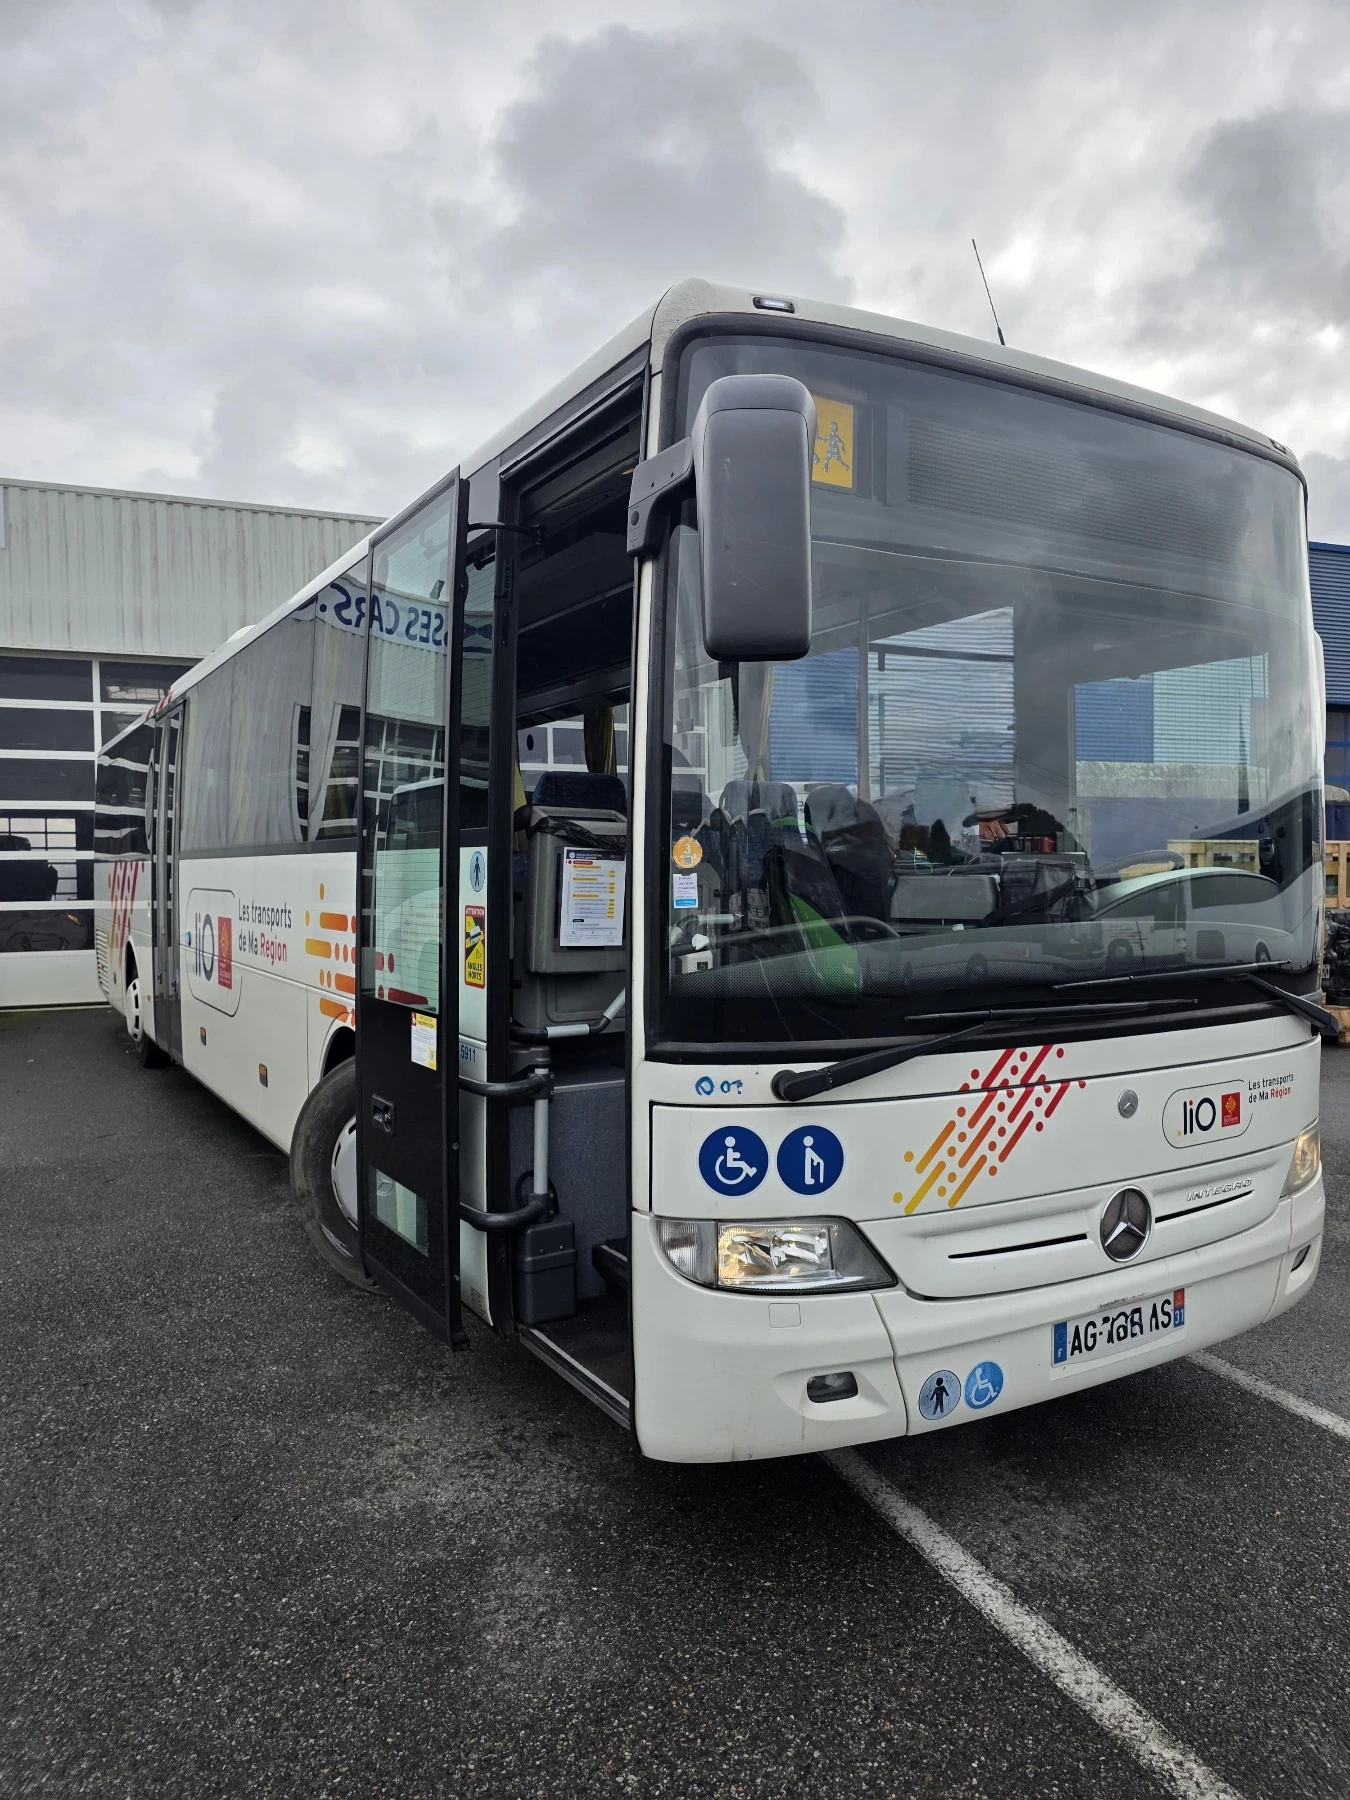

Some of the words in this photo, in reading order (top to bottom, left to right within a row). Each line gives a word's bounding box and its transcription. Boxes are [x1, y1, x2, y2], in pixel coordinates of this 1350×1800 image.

[239, 899, 249, 922] Les
[251, 901, 292, 932] transports
[239, 929, 247, 952] de
[248, 930, 258, 955] Ma
[467, 961, 483, 972] ANGLES
[460, 1045, 477, 1063] 5911
[1248, 1080, 1261, 1091] Les
[1262, 1073, 1294, 1088] transports
[1248, 1092, 1257, 1103] de
[1259, 1090, 1269, 1101] Ma
[1174, 1309, 1184, 1325] 31
